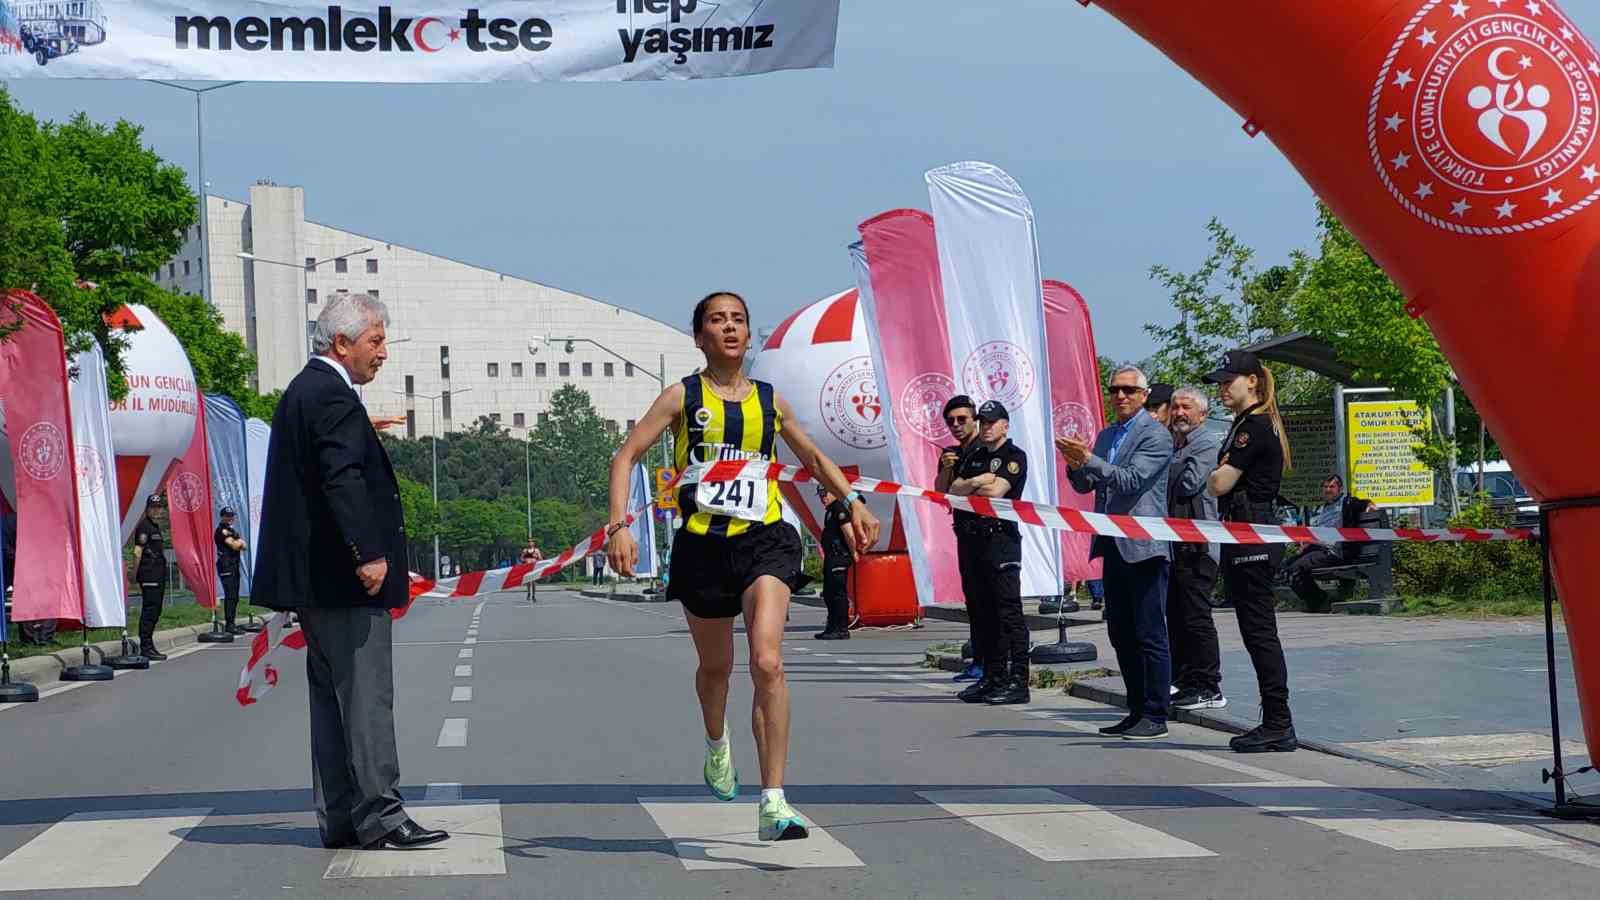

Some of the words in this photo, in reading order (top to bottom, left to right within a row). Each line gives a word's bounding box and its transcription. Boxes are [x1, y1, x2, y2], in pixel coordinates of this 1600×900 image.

[618, 24, 775, 65] yaşımız
[1479, 20, 1548, 45] GENÇLİK
[1549, 43, 1569, 62] VE
[1420, 27, 1479, 138] CUMHURİYETİ
[1564, 61, 1592, 103] SPOR
[1533, 106, 1593, 179] BAKANLIĞI
[1426, 140, 1486, 187] TÜRKİYE
[125, 374, 150, 389] UN
[708, 479, 755, 509] 241
